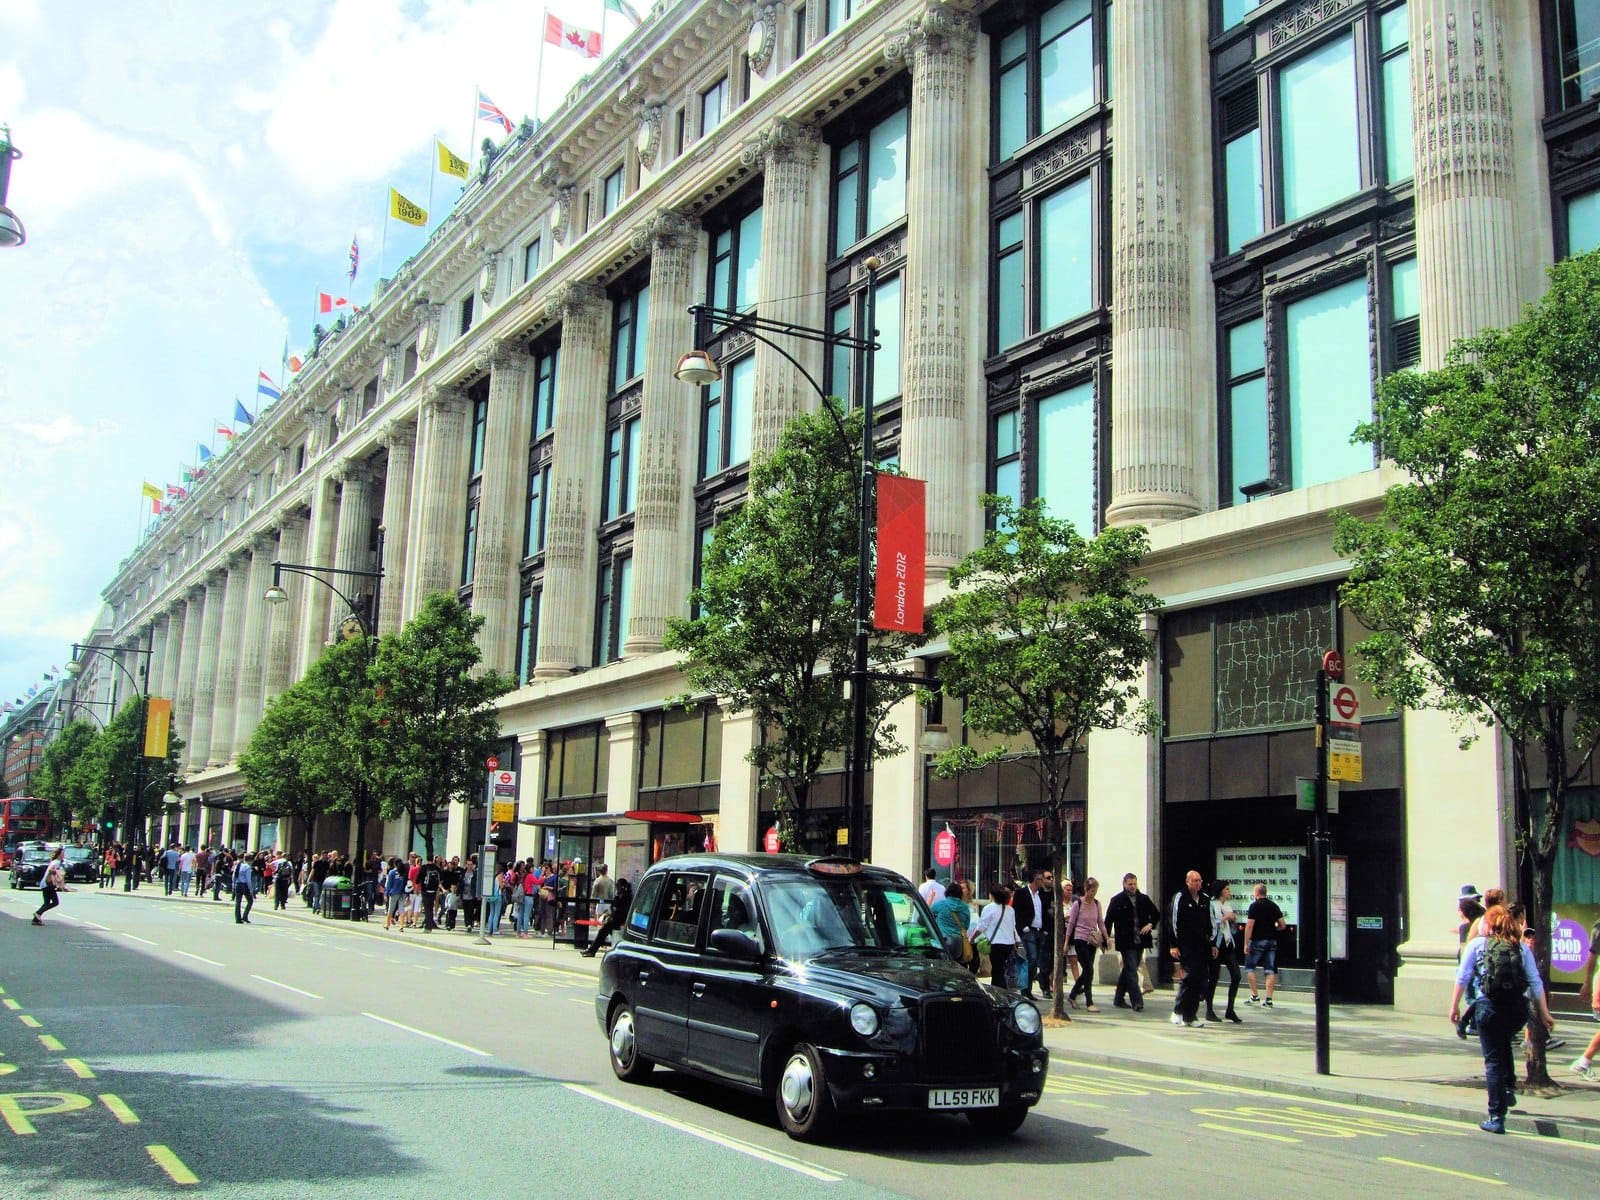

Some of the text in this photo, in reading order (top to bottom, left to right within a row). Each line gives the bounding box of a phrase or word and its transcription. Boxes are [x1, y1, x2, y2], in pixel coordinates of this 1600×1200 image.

[894, 551, 907, 625] London 2012
[1328, 660, 1342, 672] BC
[1559, 928, 1573, 938] THE
[1551, 938, 1582, 954] FOOD
[934, 1090, 995, 1106] LL59 FKK
